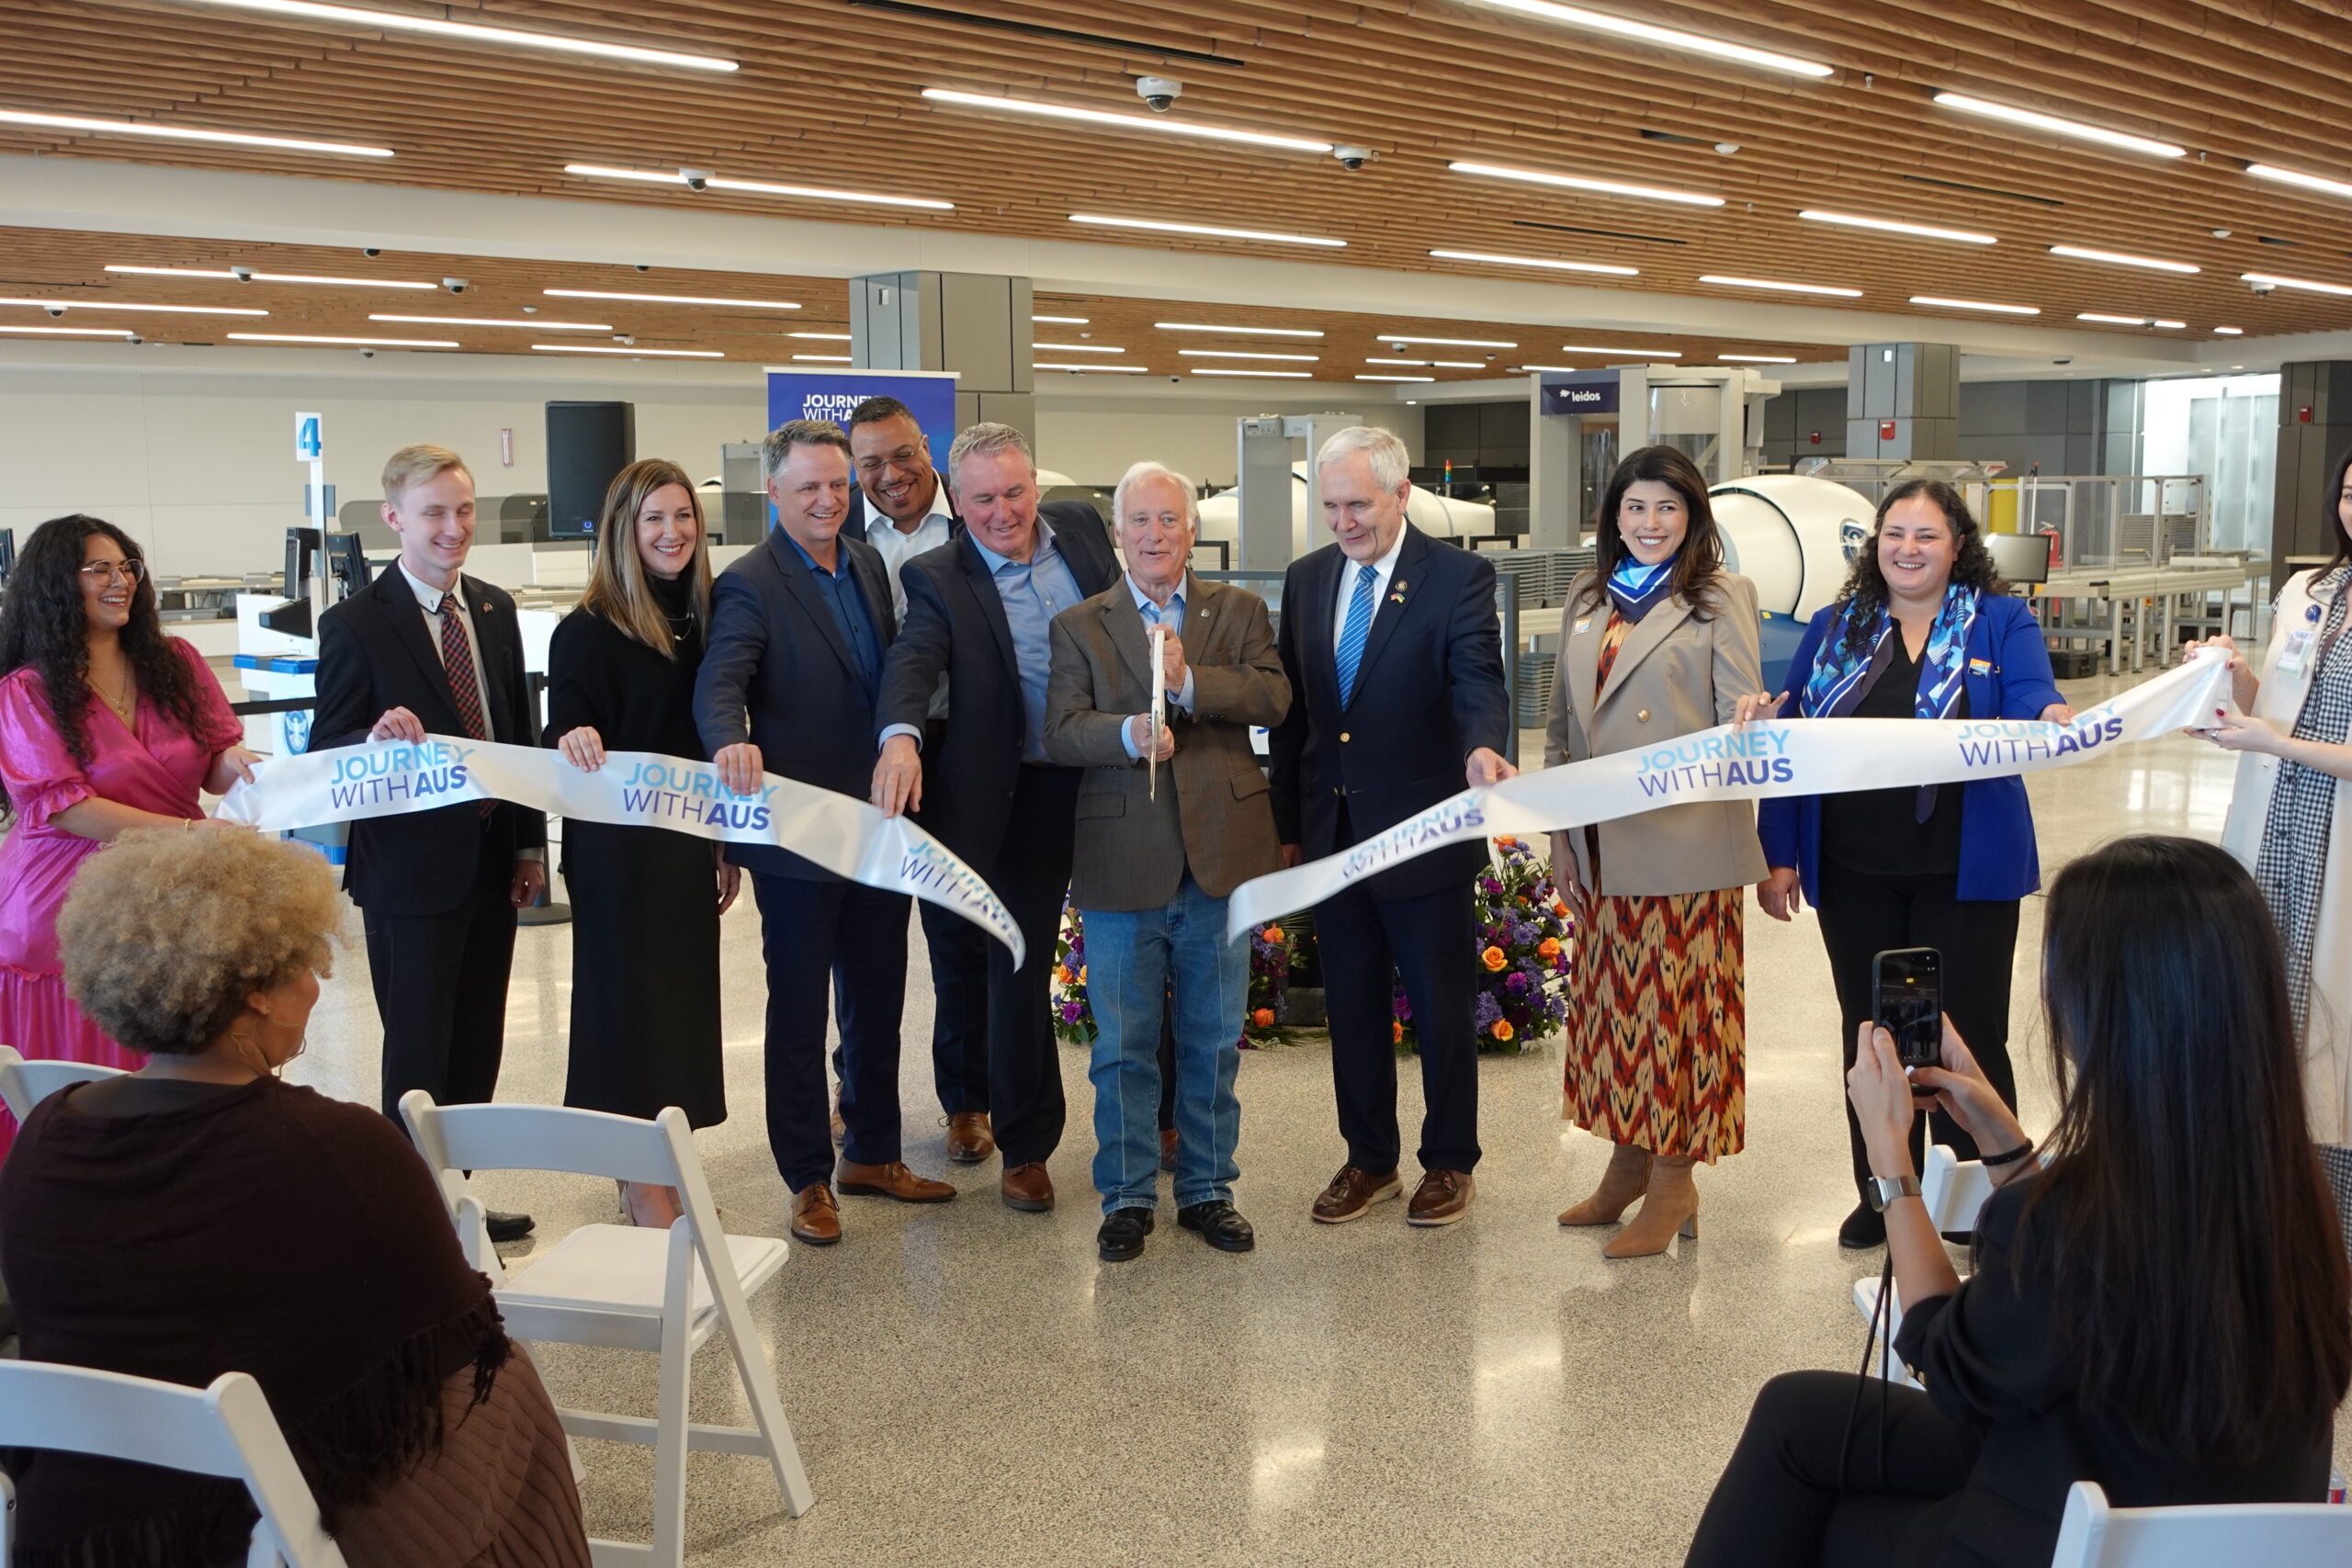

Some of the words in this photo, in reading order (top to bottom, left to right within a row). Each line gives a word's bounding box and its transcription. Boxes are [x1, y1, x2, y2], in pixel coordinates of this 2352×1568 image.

[802, 394, 871, 408] JOURNE
[802, 407, 853, 422] WITHA
[1571, 390, 1600, 402] leidos
[299, 417, 322, 457] 4
[331, 742, 476, 784] JOURNEY
[1635, 729, 1791, 774] JOURNEY
[625, 762, 779, 804] JOURNY
